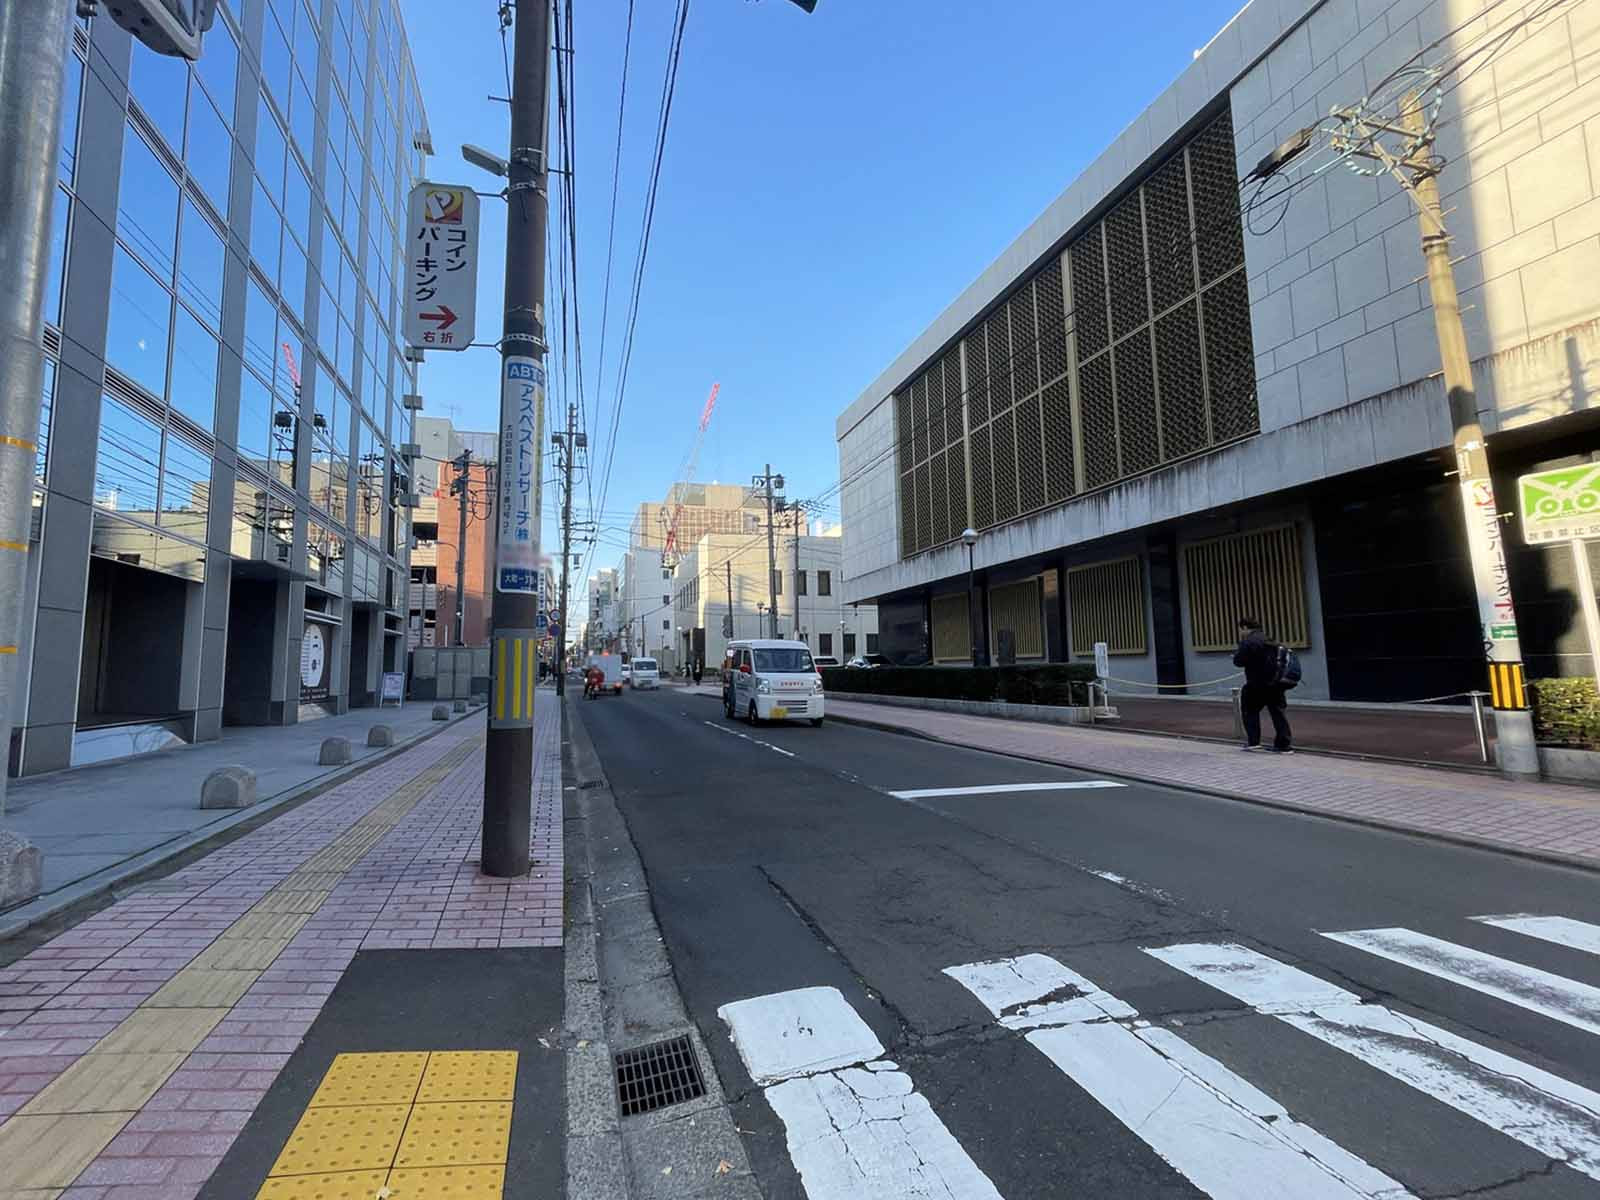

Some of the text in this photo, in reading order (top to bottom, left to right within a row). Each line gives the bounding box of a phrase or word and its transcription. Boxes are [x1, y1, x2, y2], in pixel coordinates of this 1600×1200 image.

[415, 227, 441, 302] パーキング
[446, 228, 467, 272] コイン
[423, 331, 454, 345] 右折
